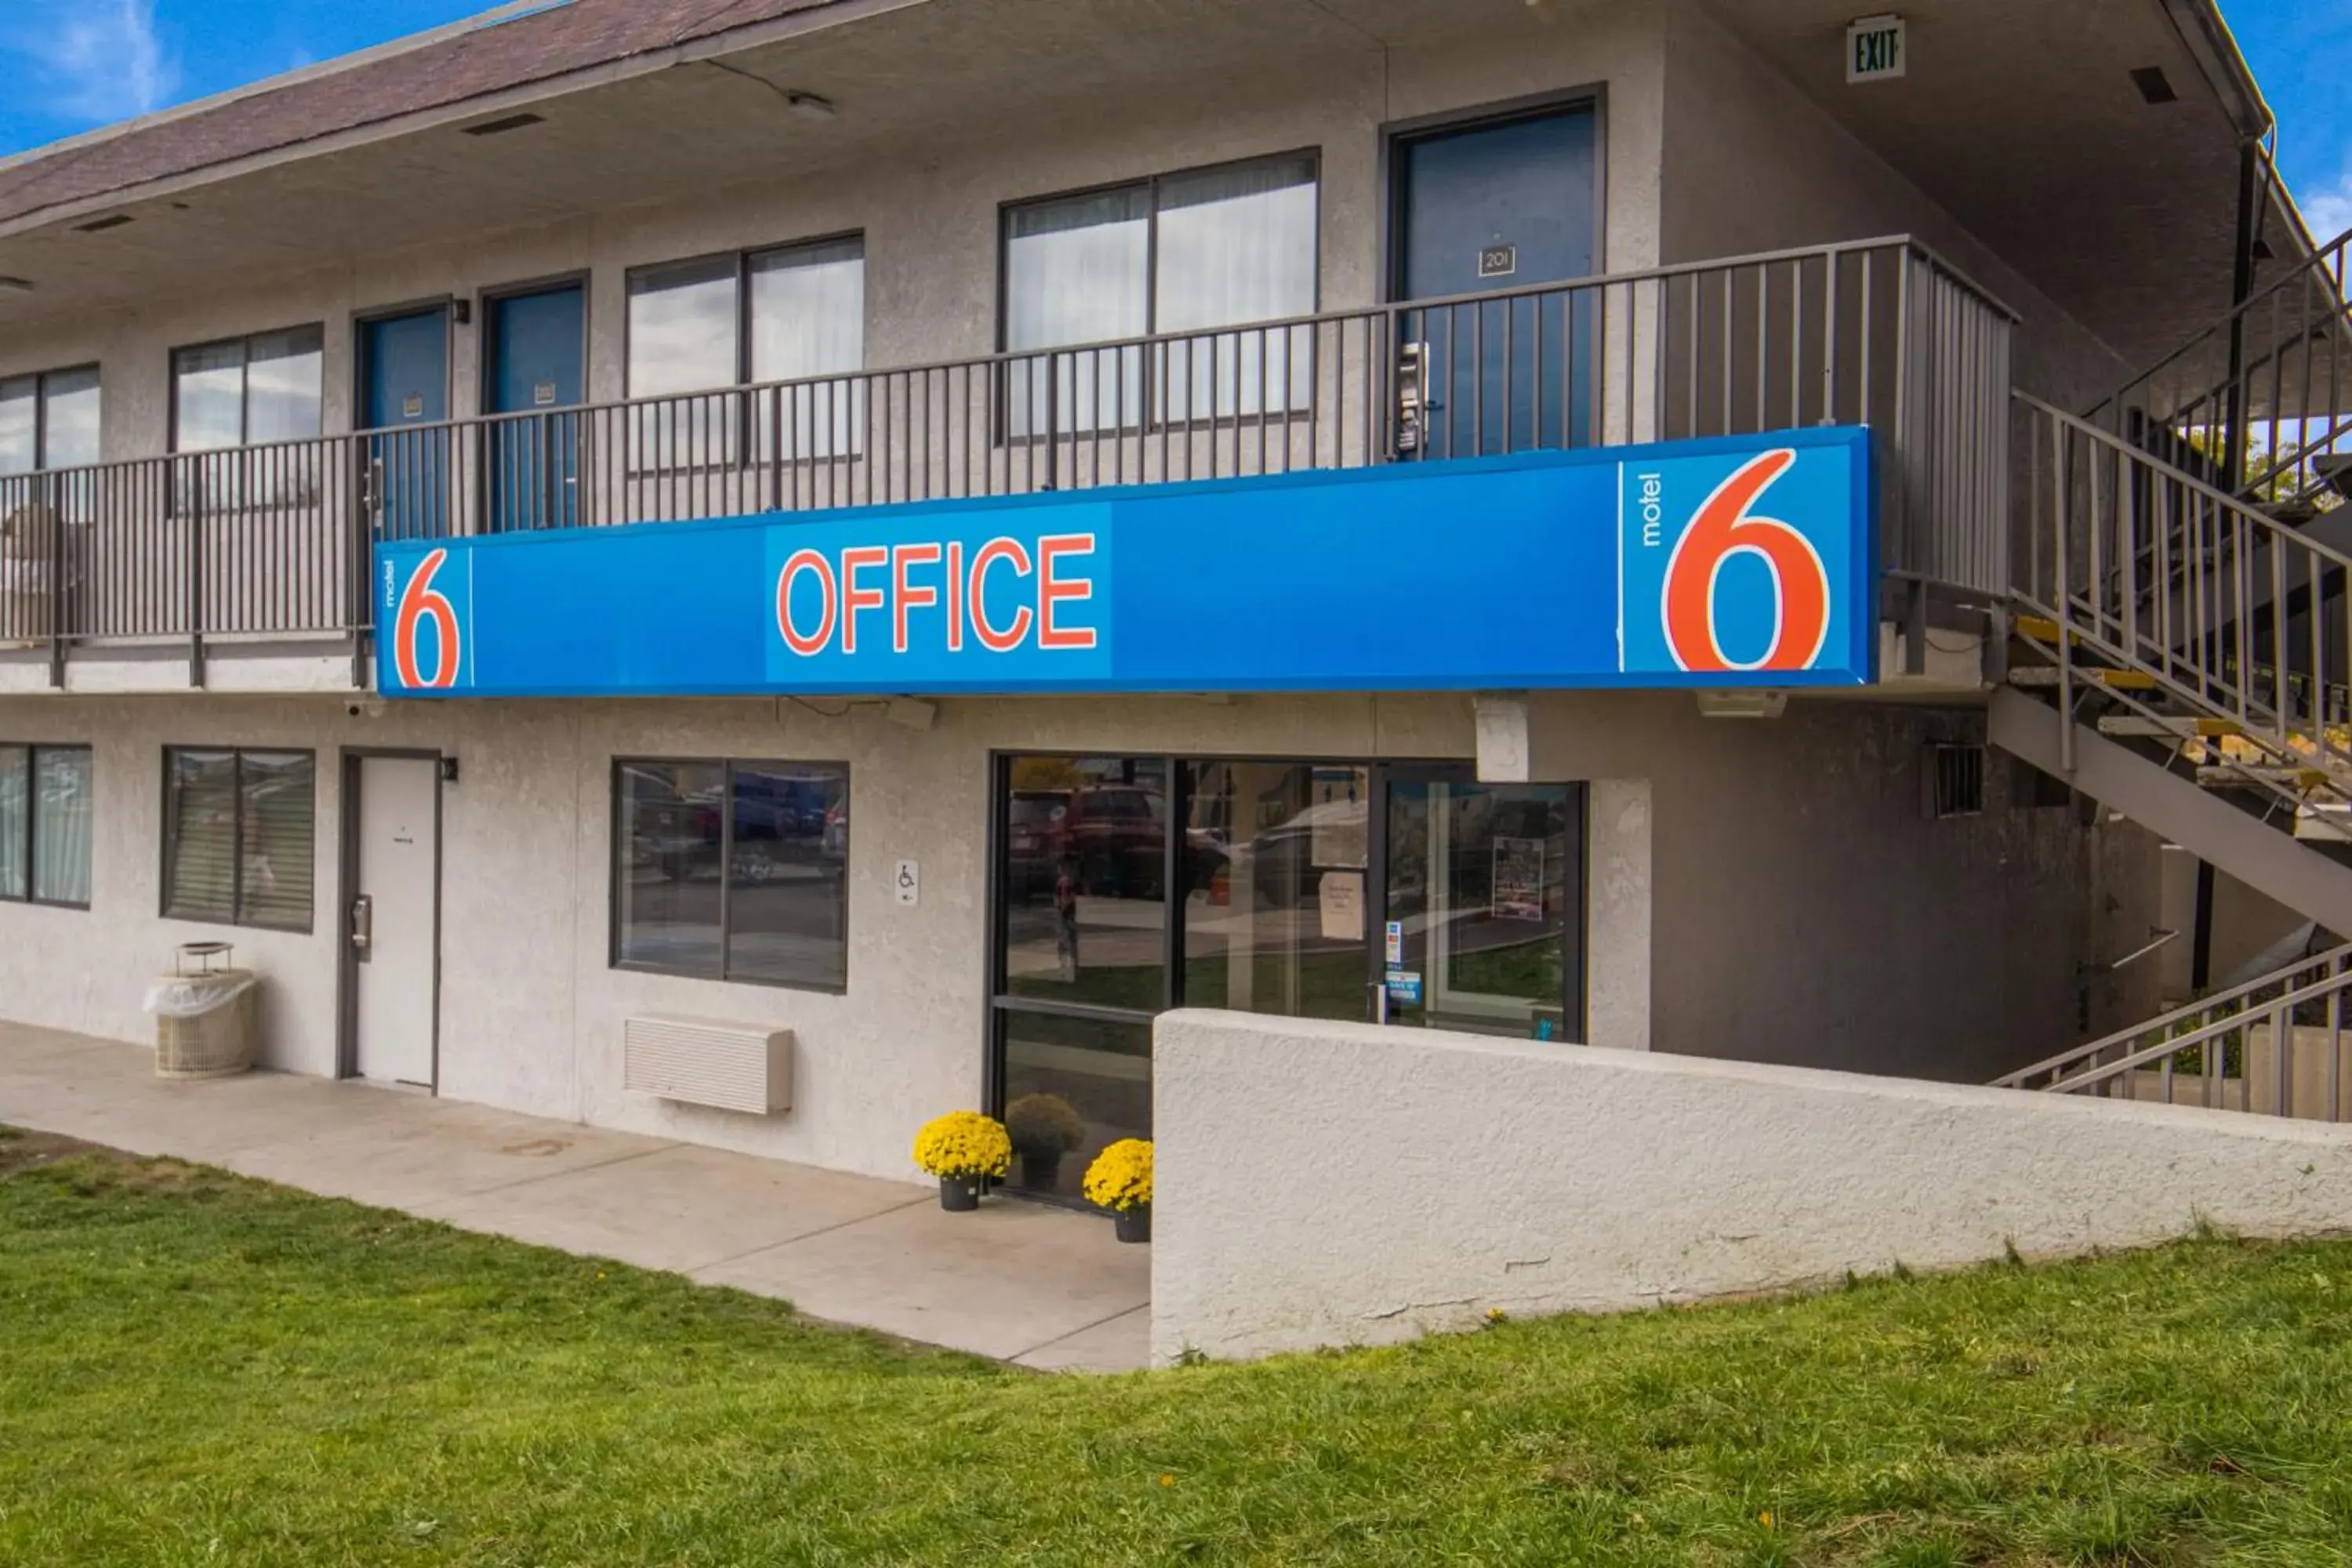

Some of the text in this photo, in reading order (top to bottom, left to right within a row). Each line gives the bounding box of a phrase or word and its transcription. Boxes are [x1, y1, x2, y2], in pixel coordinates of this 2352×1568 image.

[1856, 28, 1897, 74] EXIT
[1486, 252, 1508, 267] 201
[383, 548, 461, 688] motel 6
[776, 532, 1096, 656] OFFICE
[1638, 448, 1831, 671] motel 6
